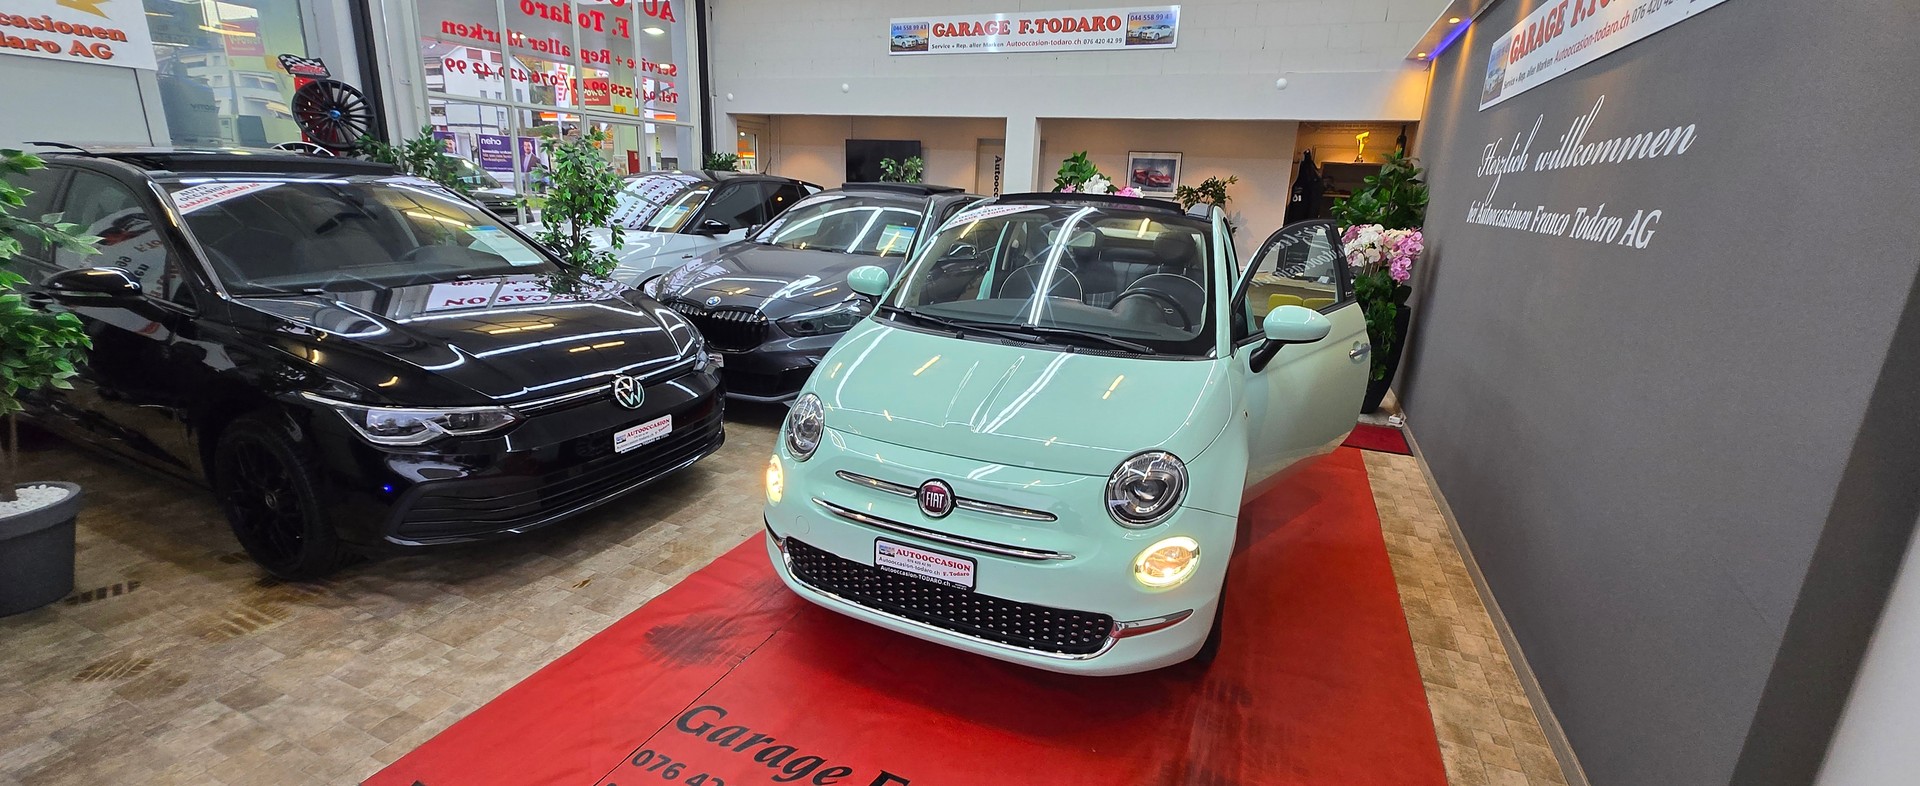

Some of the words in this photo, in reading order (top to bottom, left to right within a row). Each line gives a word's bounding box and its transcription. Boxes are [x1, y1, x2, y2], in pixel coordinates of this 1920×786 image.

[932, 20, 1011, 38] GARAGE
[1018, 15, 1122, 35] F.TODARO
[1509, 0, 1568, 65] GARAGE
[69, 40, 114, 60] AG
[480, 136, 502, 146] neho
[1477, 113, 1544, 205] Herzlich
[1535, 94, 1698, 171] willkommen
[1466, 200, 1481, 223] bei
[1529, 206, 1571, 237] Franco
[1569, 203, 1624, 244] Todaro
[1618, 209, 1662, 249] AG
[925, 491, 945, 509] FIAT
[896, 548, 971, 572] AUTOOCCASION
[676, 705, 853, 786] Garage
[631, 749, 687, 781] 076
